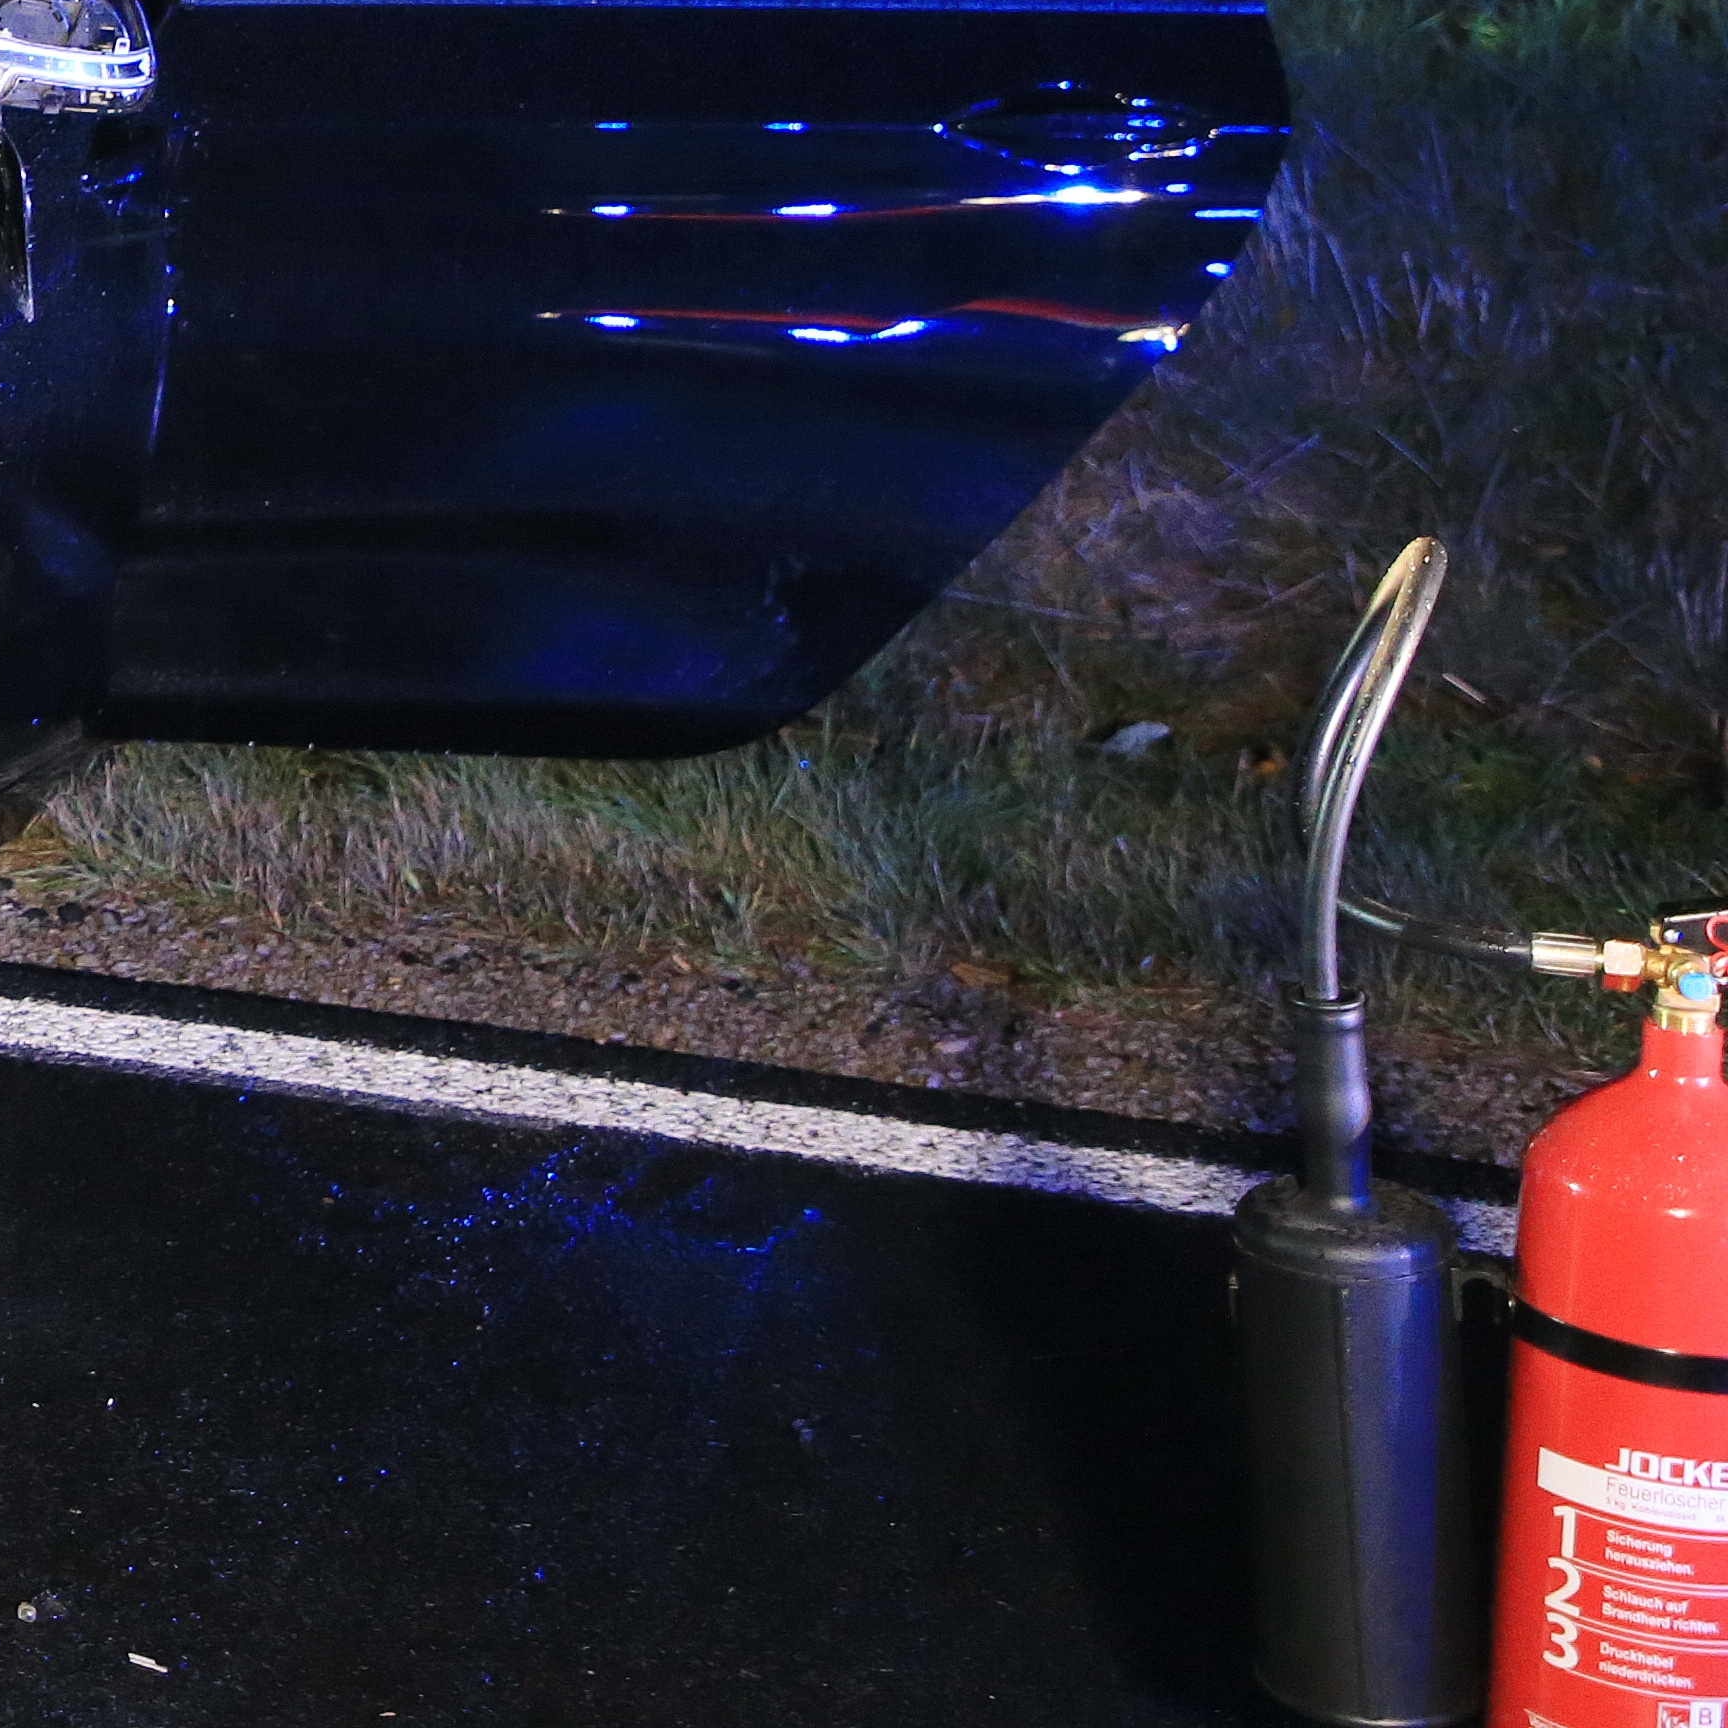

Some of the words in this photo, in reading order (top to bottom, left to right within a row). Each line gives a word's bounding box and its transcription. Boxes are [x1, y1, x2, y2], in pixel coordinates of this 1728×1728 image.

[1553, 1505, 1576, 1558] 1
[1605, 1529, 1673, 1558] Sicherung
[1544, 1556, 1581, 1617] 2
[1602, 1584, 1663, 1613] Schlauch
[1665, 1600, 1690, 1614] auf
[1601, 1601, 1671, 1631] Brandherd
[1542, 1612, 1579, 1670] 3
[1599, 1641, 1675, 1670] Druckhebel
[1699, 1707, 1712, 1725] B
